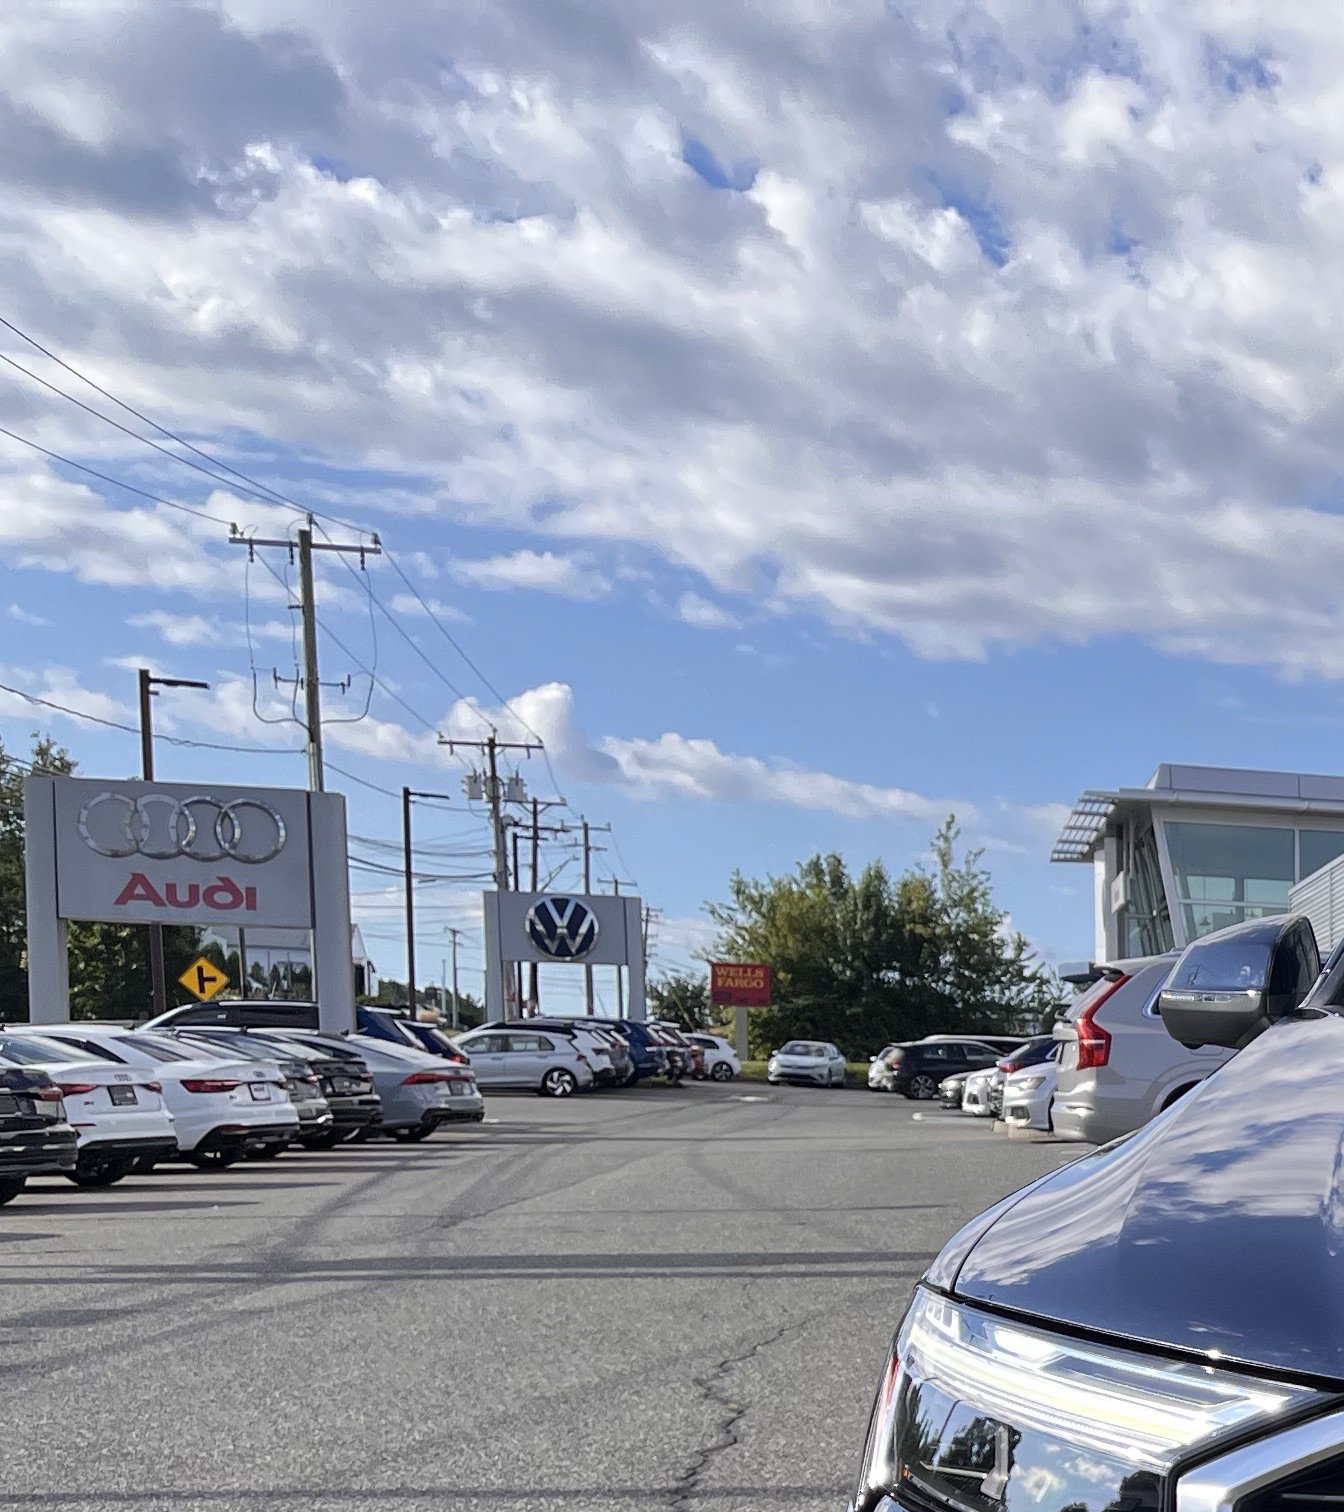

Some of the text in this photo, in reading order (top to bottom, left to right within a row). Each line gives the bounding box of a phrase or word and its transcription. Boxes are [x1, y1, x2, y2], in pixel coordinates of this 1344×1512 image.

[114, 872, 257, 911] Audi
[714, 966, 765, 977] WELLS
[716, 977, 765, 988] FARGO
